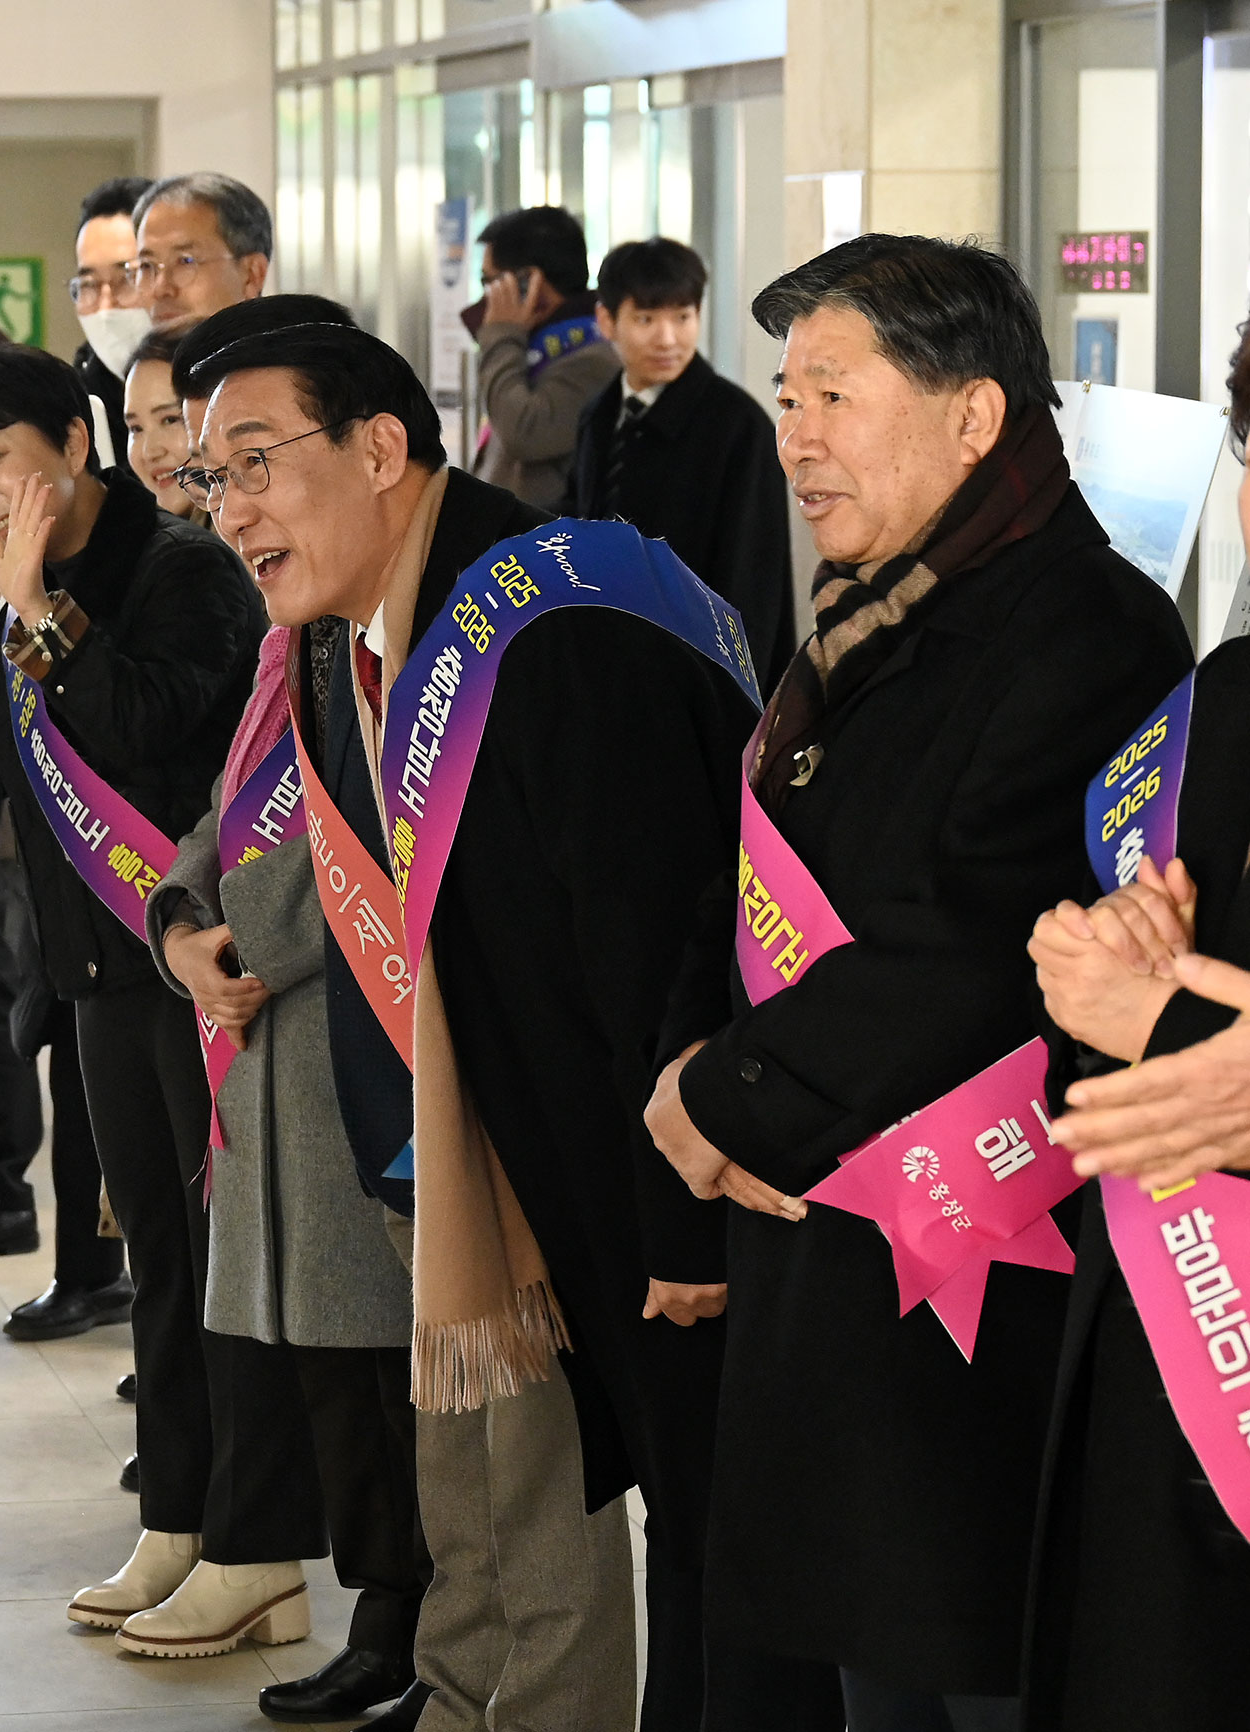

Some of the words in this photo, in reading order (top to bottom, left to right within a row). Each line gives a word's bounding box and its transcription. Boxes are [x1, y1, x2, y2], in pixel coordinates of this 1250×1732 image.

[489, 554, 542, 609] 2025
[452, 593, 497, 655] 2026
[18, 687, 37, 738] 2026
[397, 645, 464, 818] 충청남도
[1103, 714, 1169, 788] 2025
[30, 727, 111, 852] 충청남도
[1100, 766, 1162, 842] 2026
[974, 1117, 1038, 1183] 해
[928, 1181, 973, 1233] 홍성군
[1160, 1206, 1250, 1393] 방문의
